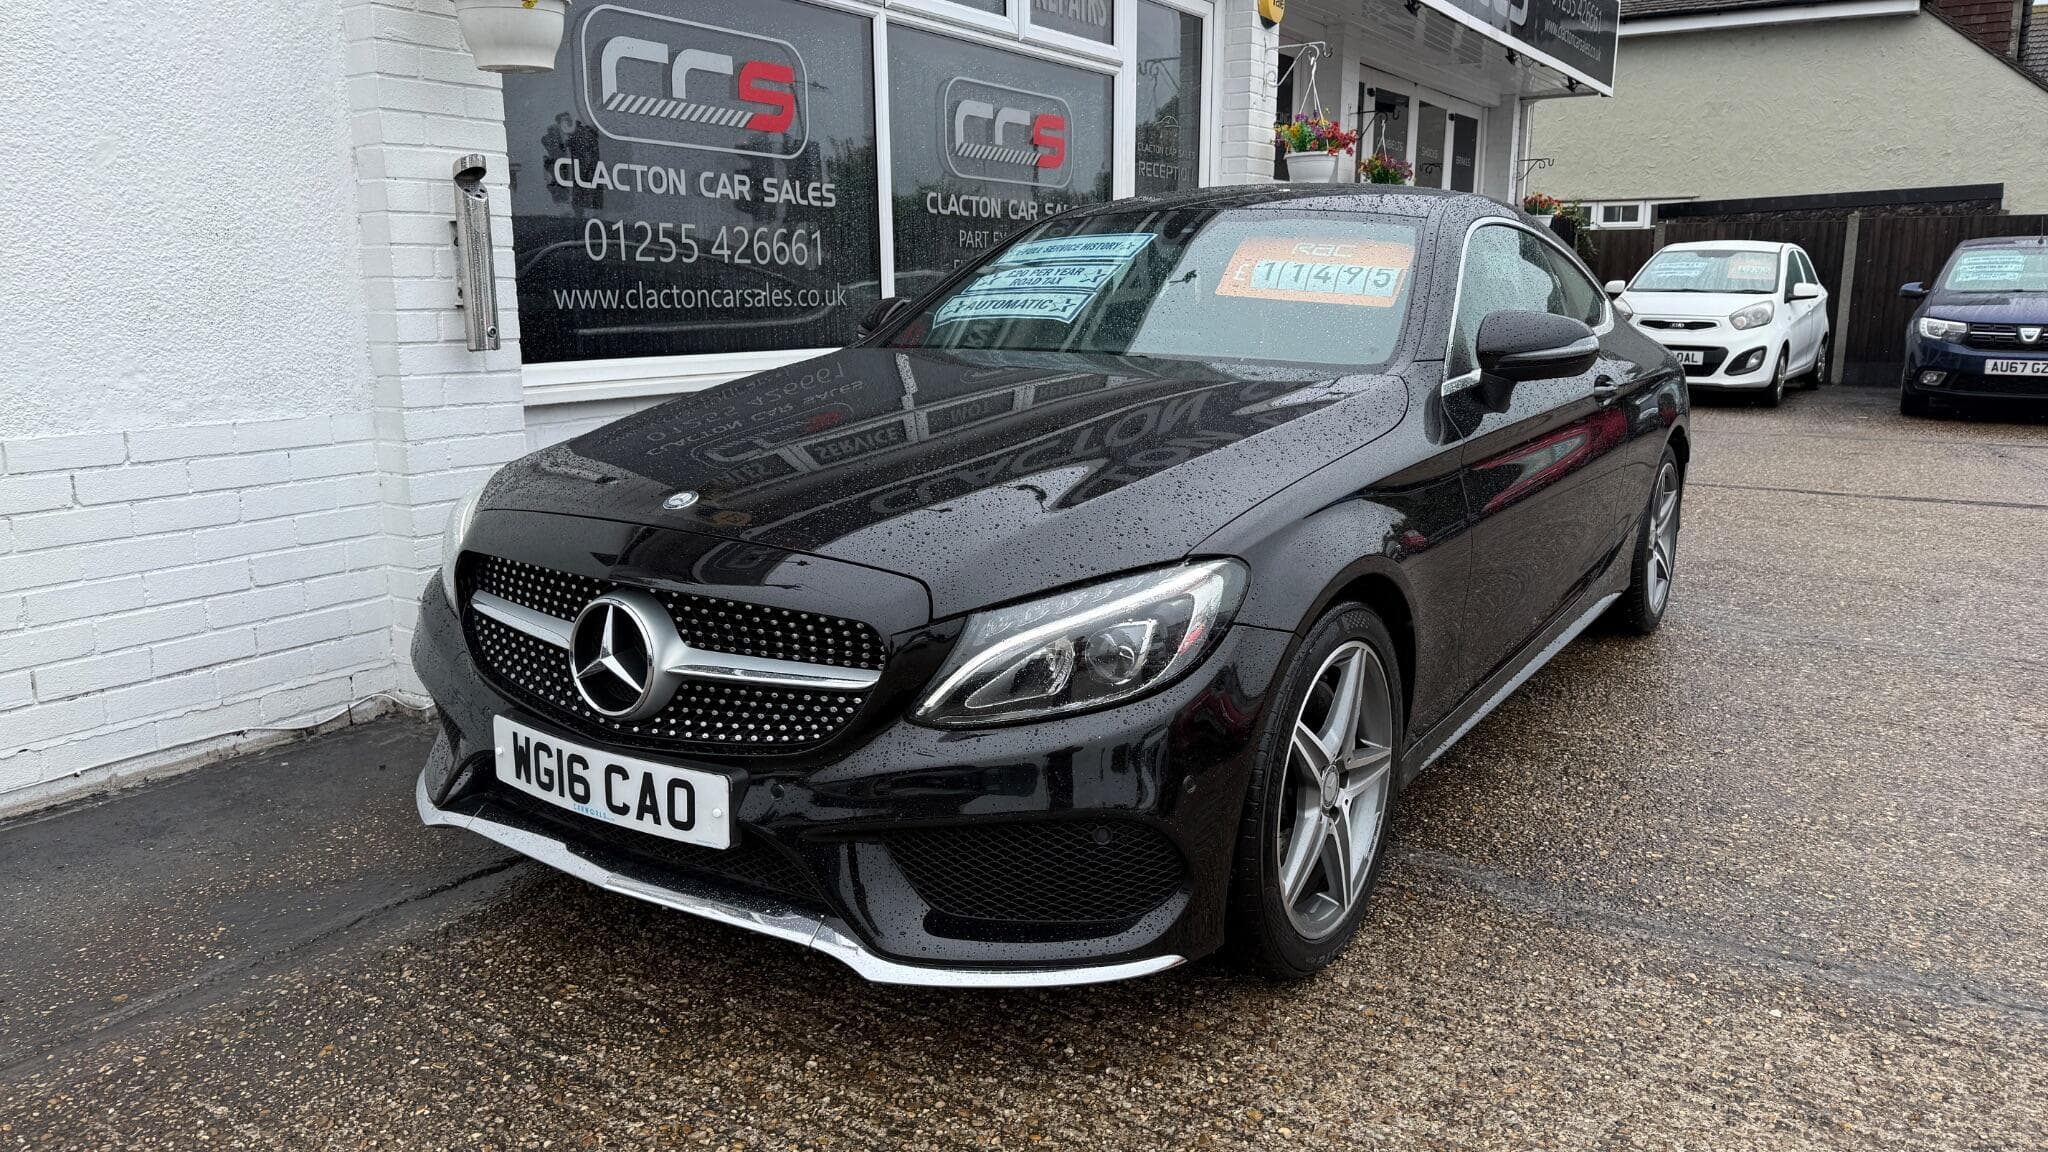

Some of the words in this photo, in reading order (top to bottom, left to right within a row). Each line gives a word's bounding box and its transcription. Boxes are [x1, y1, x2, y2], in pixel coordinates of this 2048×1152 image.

[1035, 0, 1107, 27] AIRS
[1138, 160, 1195, 182] RECEPTION
[553, 157, 686, 196] CLACTON
[699, 171, 751, 202] CAR
[763, 178, 837, 208] SALES
[925, 191, 1001, 220] CLACTON
[1008, 199, 1039, 221] CAR
[584, 217, 700, 264] 01255
[710, 225, 823, 267] 426661
[959, 229, 989, 249] PART
[1044, 243, 1080, 254] SERVICE
[1079, 241, 1123, 252] HISTORY
[1009, 277, 1041, 287] ROAD
[1040, 276, 1065, 286] TAX
[1029, 267, 1055, 277] PER
[1054, 266, 1086, 277] YEAR
[552, 281, 848, 311] www.clactoncarsales.co.uk
[966, 299, 1052, 311] AUTOMATIC
[1991, 360, 2028, 373] AU67
[512, 730, 592, 805] WG16
[604, 763, 696, 832] CAO
